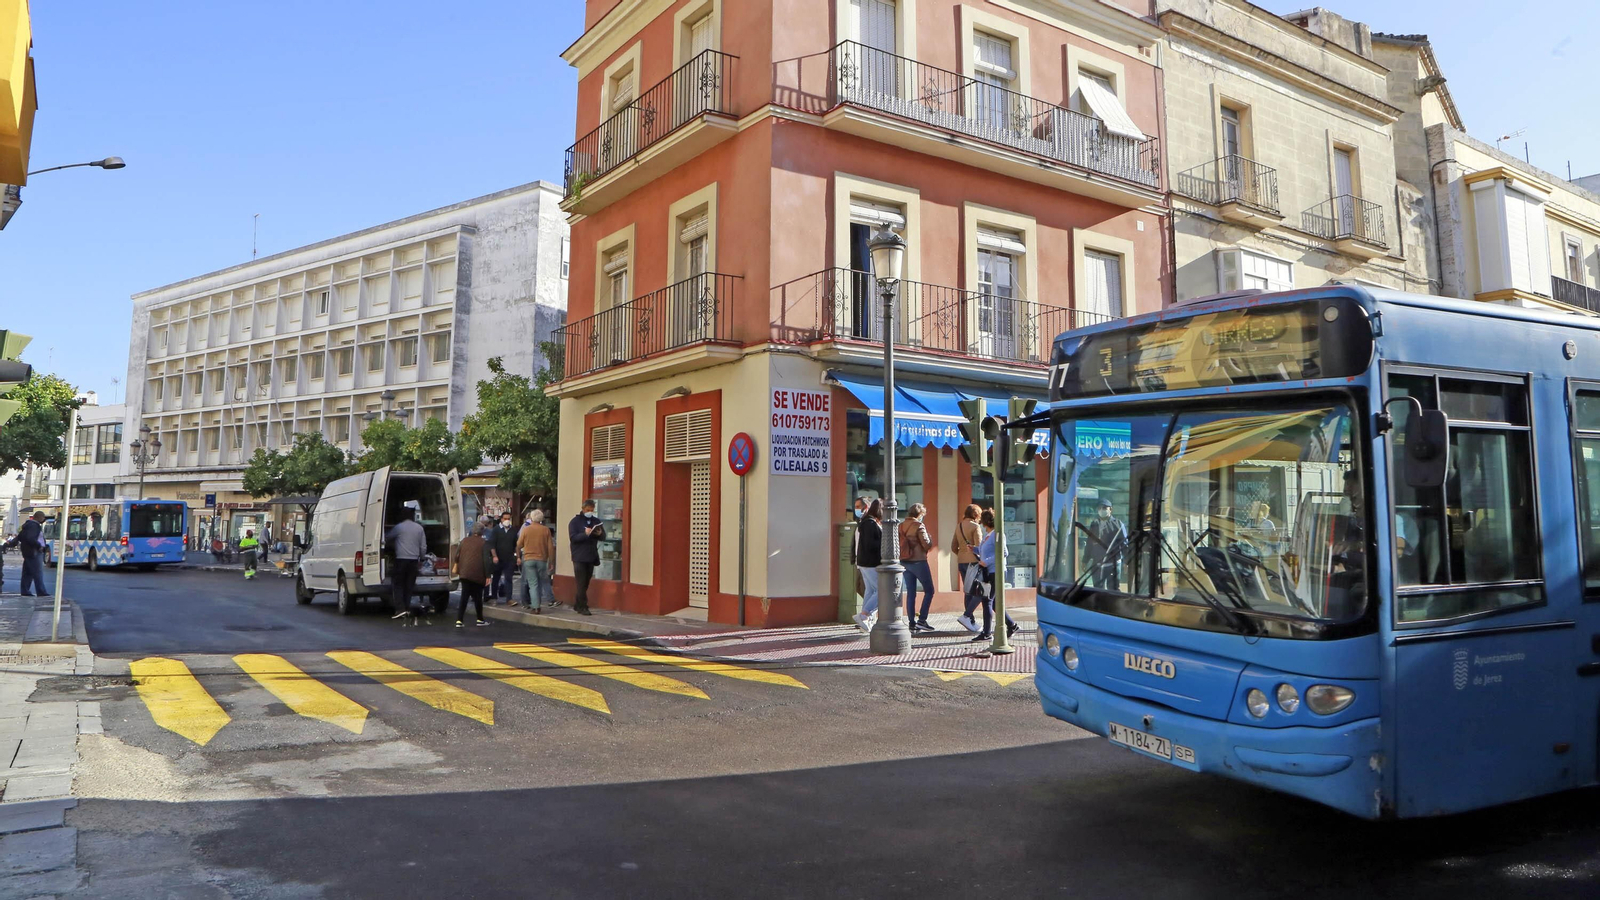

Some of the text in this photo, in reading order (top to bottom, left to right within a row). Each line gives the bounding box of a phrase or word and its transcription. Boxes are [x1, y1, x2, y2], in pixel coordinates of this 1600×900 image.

[774, 390, 829, 412] SE VENDE
[772, 413, 830, 431] 610759173
[944, 425, 957, 438] de
[772, 434, 830, 447] LIQUIDACION PATCHWORK
[773, 446, 828, 459] POR TRASLADO A:
[774, 459, 828, 473] C/LEALAS 9
[1124, 652, 1176, 679] IVECO
[1474, 652, 1525, 667] Ayuntamiento
[1473, 674, 1502, 687] de Jerez
[1175, 746, 1194, 760] SP
